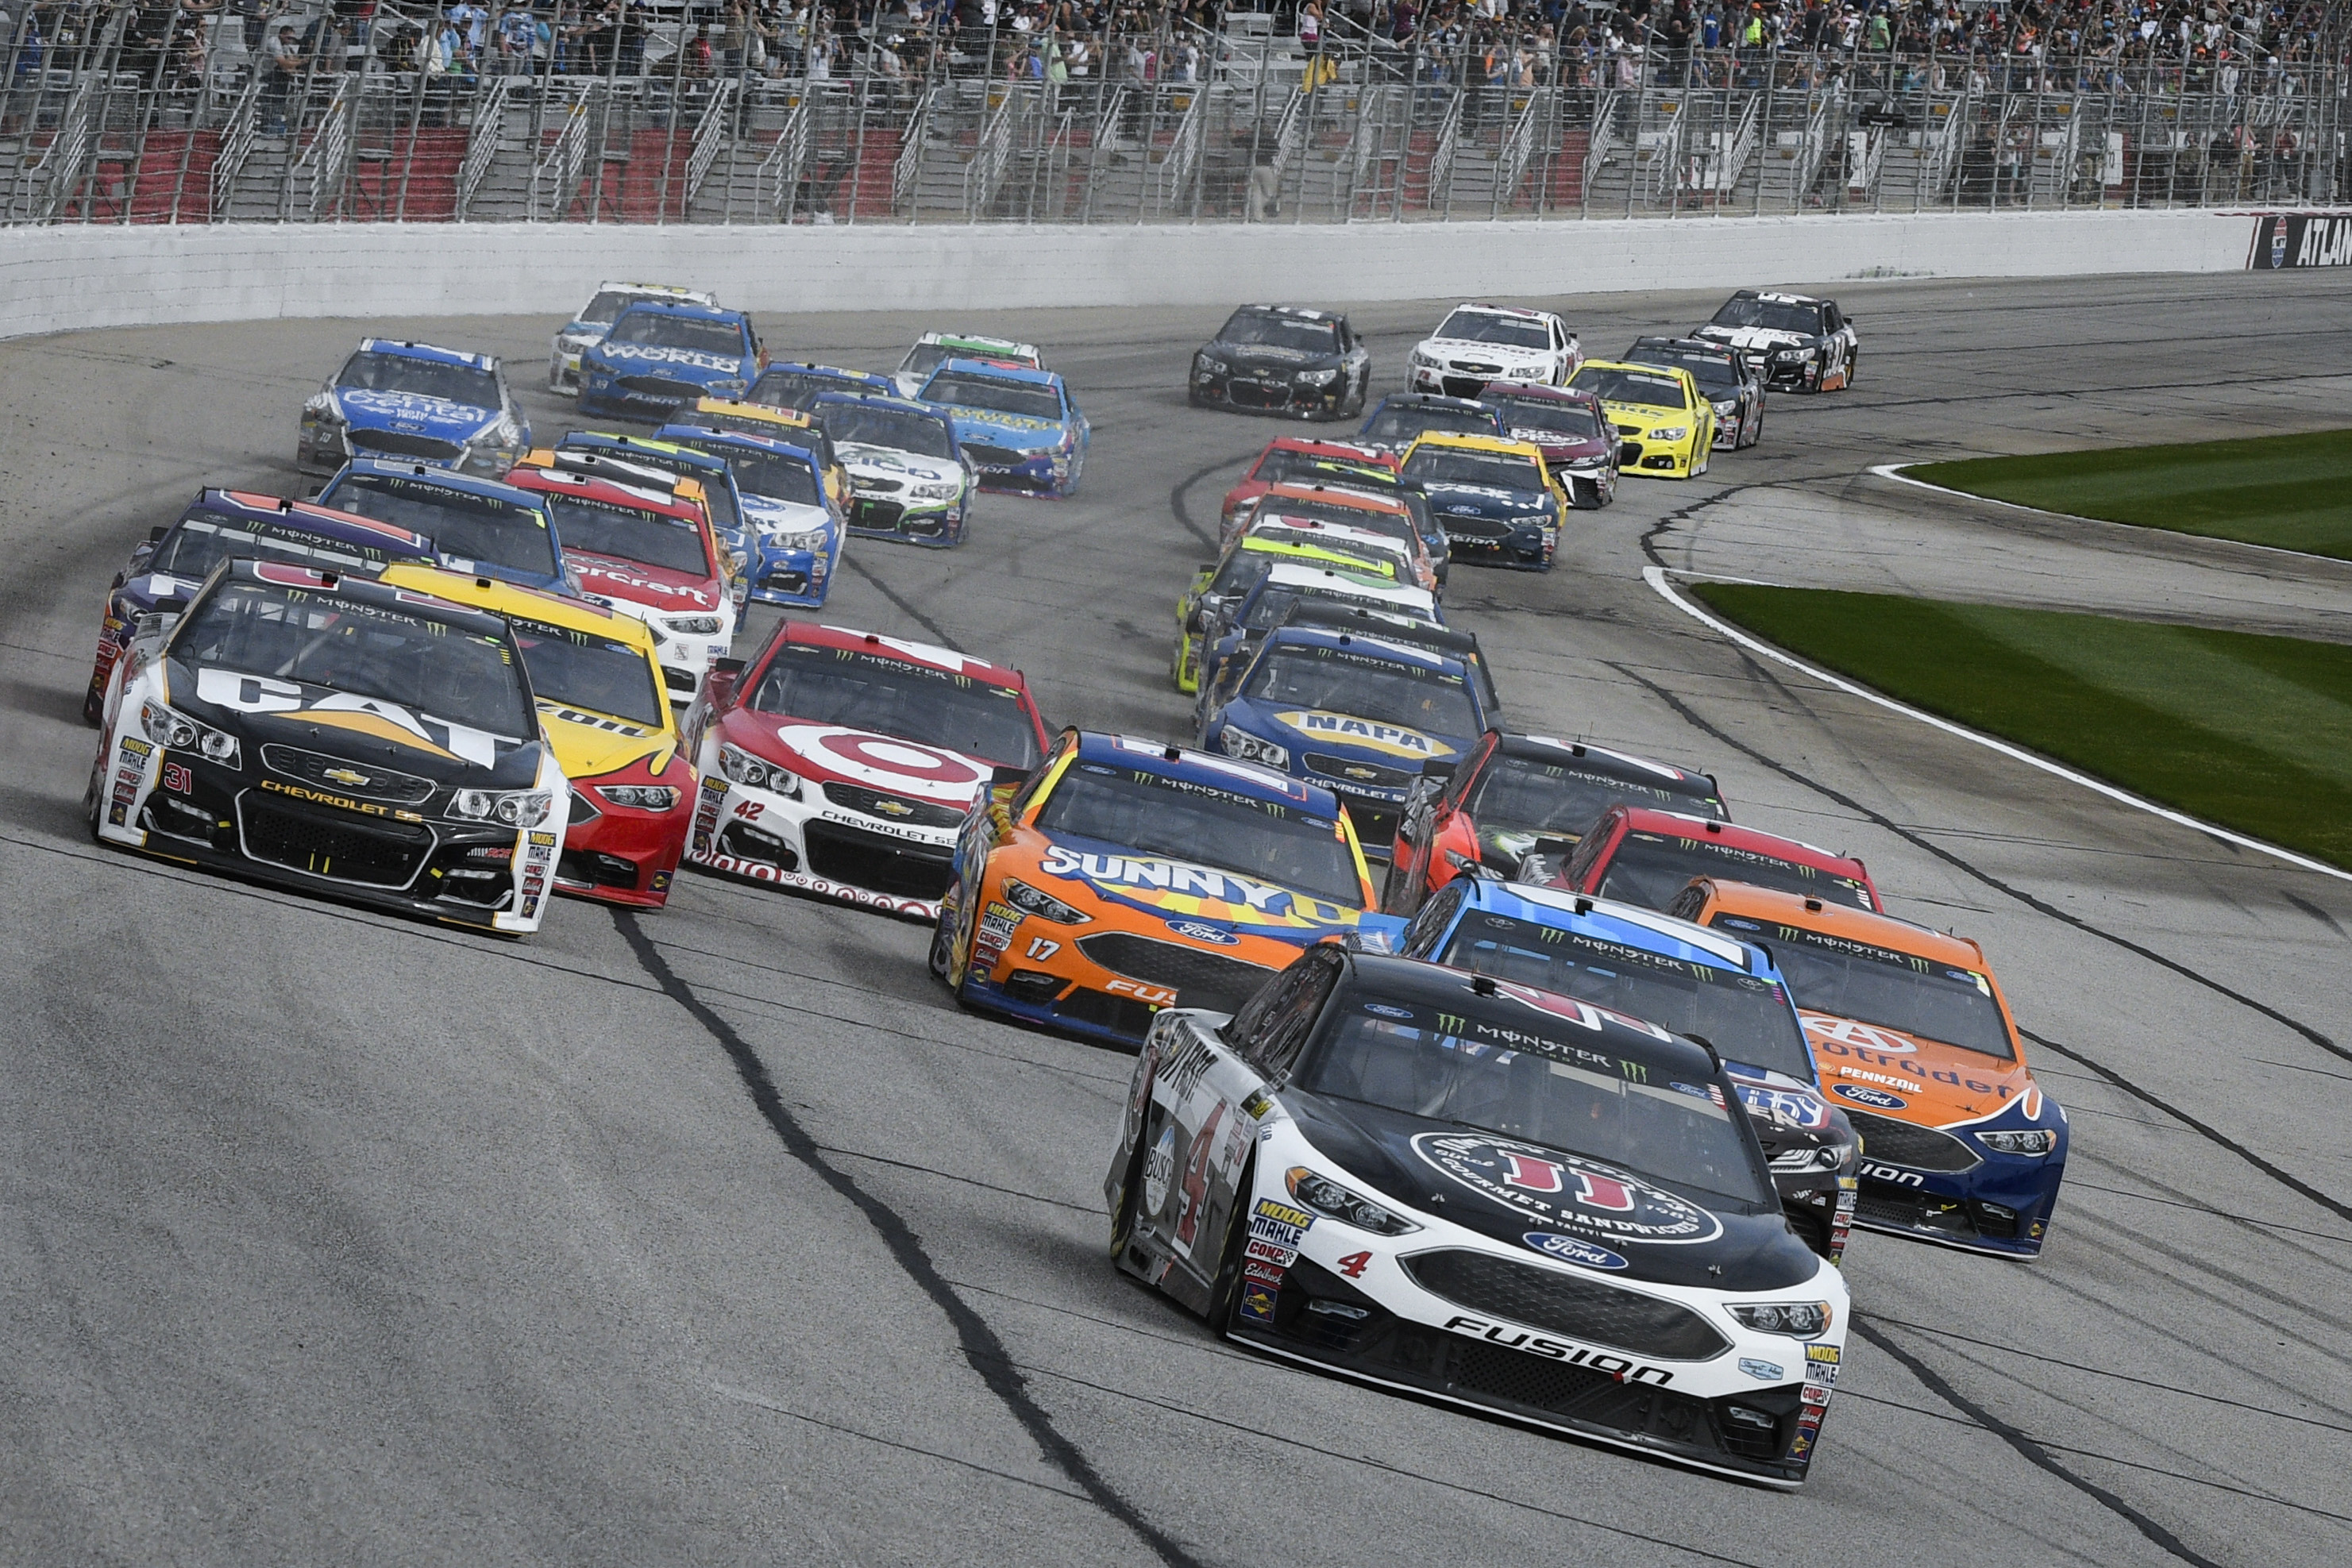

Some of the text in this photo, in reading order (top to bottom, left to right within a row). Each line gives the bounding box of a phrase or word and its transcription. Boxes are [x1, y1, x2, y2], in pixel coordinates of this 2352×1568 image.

[2296, 218, 2352, 266] ATLAN
[410, 483, 482, 503] MONSTER
[568, 497, 637, 516] MONSTER
[272, 526, 357, 553] MONSTER
[316, 597, 418, 627] MONSTER
[861, 654, 948, 680] MONSTER
[1337, 652, 1405, 671] MONSTER
[197, 667, 521, 770] CAT
[1306, 714, 1428, 753] NAPA
[122, 738, 153, 756] MOOG
[119, 750, 148, 771] MAHLE
[164, 761, 192, 795] 31
[1303, 776, 1389, 800] CHEVROLET
[1568, 769, 1649, 794] MONSTER
[260, 779, 422, 823] CHEVROLET SS
[1161, 777, 1259, 808] MONSTER
[734, 799, 765, 821] 42
[530, 831, 555, 846] MOOG
[821, 810, 930, 843] CHEVROLET
[1705, 843, 1792, 870] MONSTER
[1042, 845, 1282, 909] SUNNY
[982, 914, 1016, 935] MAHLE
[988, 902, 1023, 923] MOOG
[1178, 922, 1226, 942] Ford
[1025, 936, 1061, 962] 17
[1571, 936, 1684, 972] MONSTER
[1598, 951, 1661, 970] ENERGY
[1806, 934, 1903, 964] MONSTER
[1372, 1004, 1406, 1017] Ford
[1476, 1024, 1612, 1069] MONSTER
[1510, 1043, 1583, 1067] ENERGY
[1676, 1084, 1710, 1099] Ford
[1840, 1065, 1923, 1094] PENNZOIL
[1845, 1086, 1892, 1108] Ford
[1171, 1096, 1228, 1260] 4
[1440, 1157, 1701, 1235] GOURMET SANDWICHES
[1257, 1200, 1313, 1228] MOOG
[1251, 1216, 1303, 1246] MAHLE
[1248, 1241, 1285, 1259] COMP
[1542, 1235, 1608, 1266] Ford
[1337, 1250, 1374, 1279] 4
[1443, 1316, 1675, 1385] FUSION
[1806, 1344, 1840, 1363] MOOG
[1805, 1362, 1837, 1384] MAHLE
